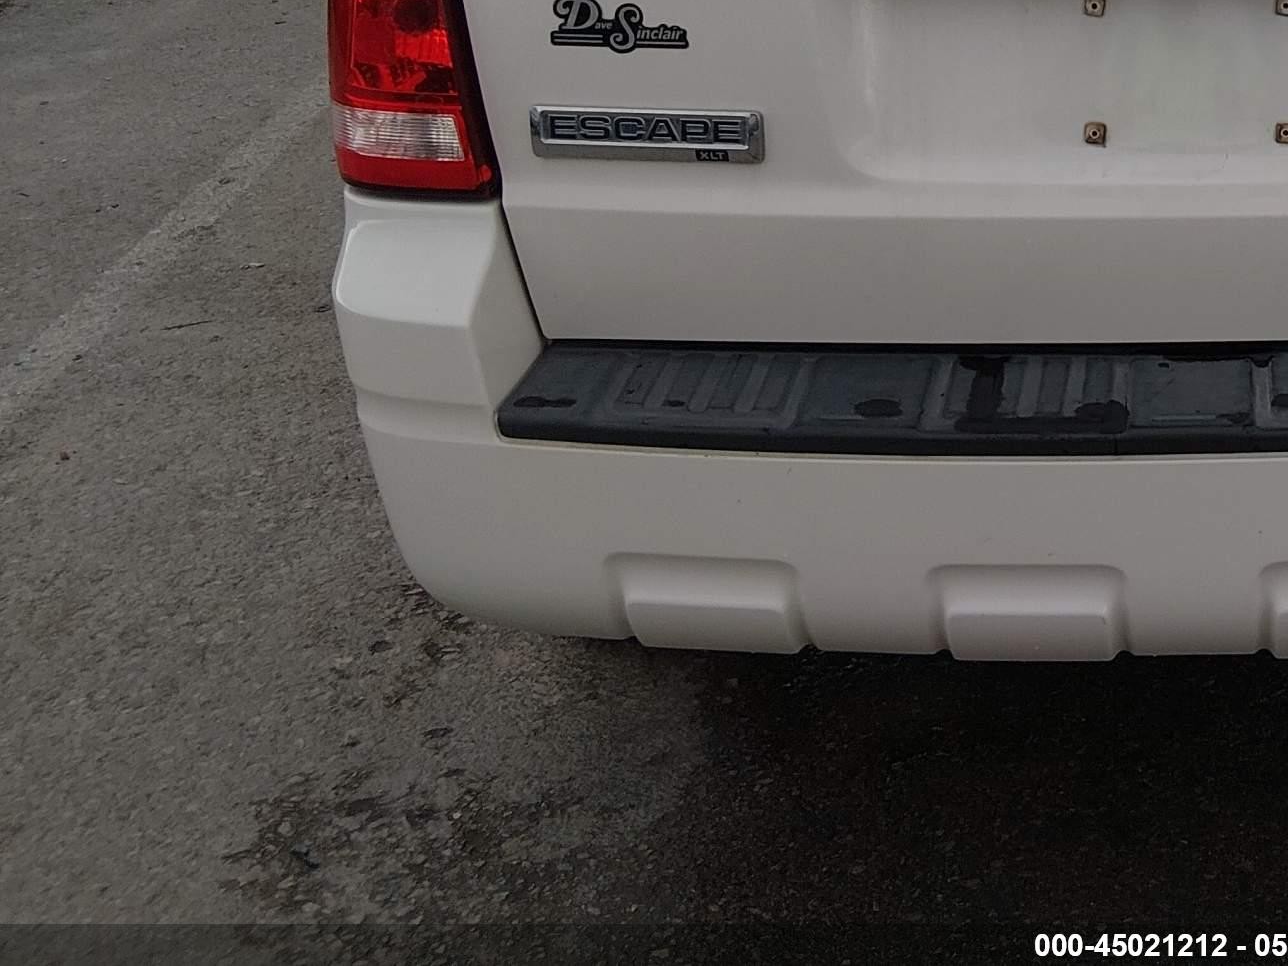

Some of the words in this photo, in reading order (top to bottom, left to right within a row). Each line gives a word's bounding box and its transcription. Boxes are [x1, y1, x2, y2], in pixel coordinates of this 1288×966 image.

[609, 4, 684, 52] Sinclair
[547, 113, 743, 145] ESCAPE
[699, 150, 726, 161] XLT
